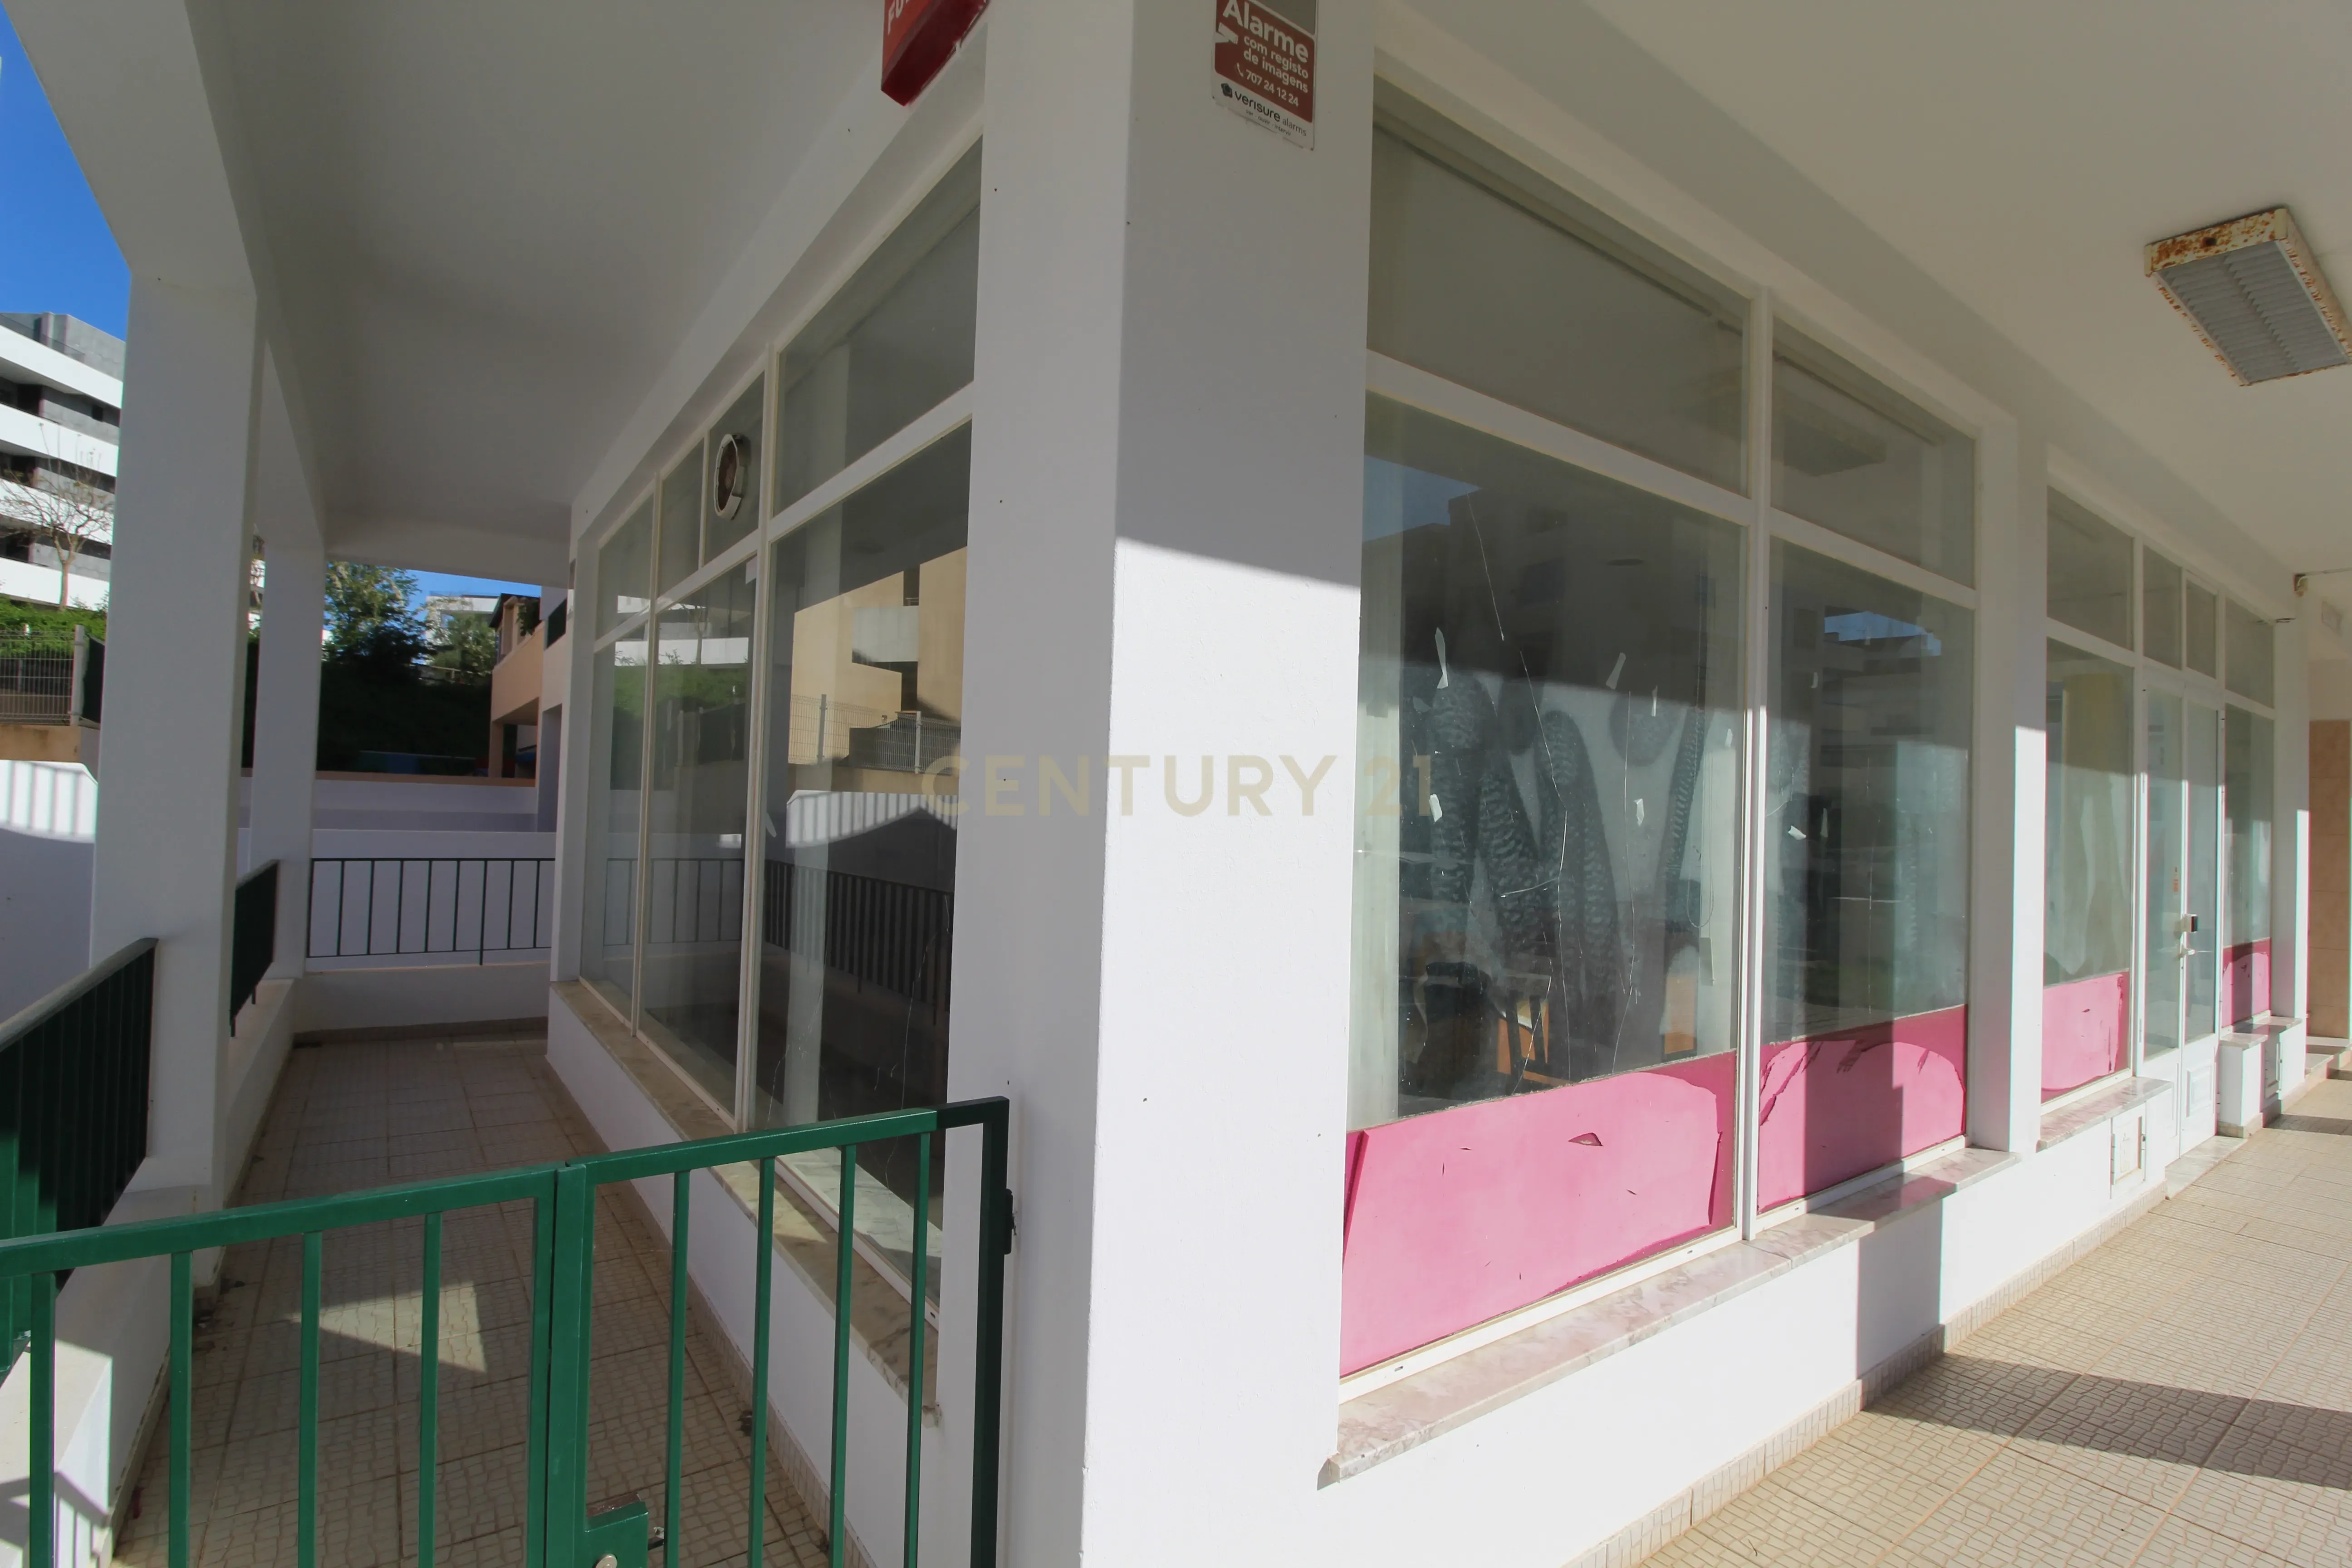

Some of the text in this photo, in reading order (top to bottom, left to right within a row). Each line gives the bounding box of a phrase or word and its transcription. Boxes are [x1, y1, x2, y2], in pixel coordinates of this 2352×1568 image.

[1223, 0, 1308, 63] Alarme
[1244, 36, 1308, 78] com registo
[1244, 48, 1308, 93] de imagens
[1246, 69, 1299, 107] 707 24 12 24
[1235, 91, 1307, 136] verisure alarms
